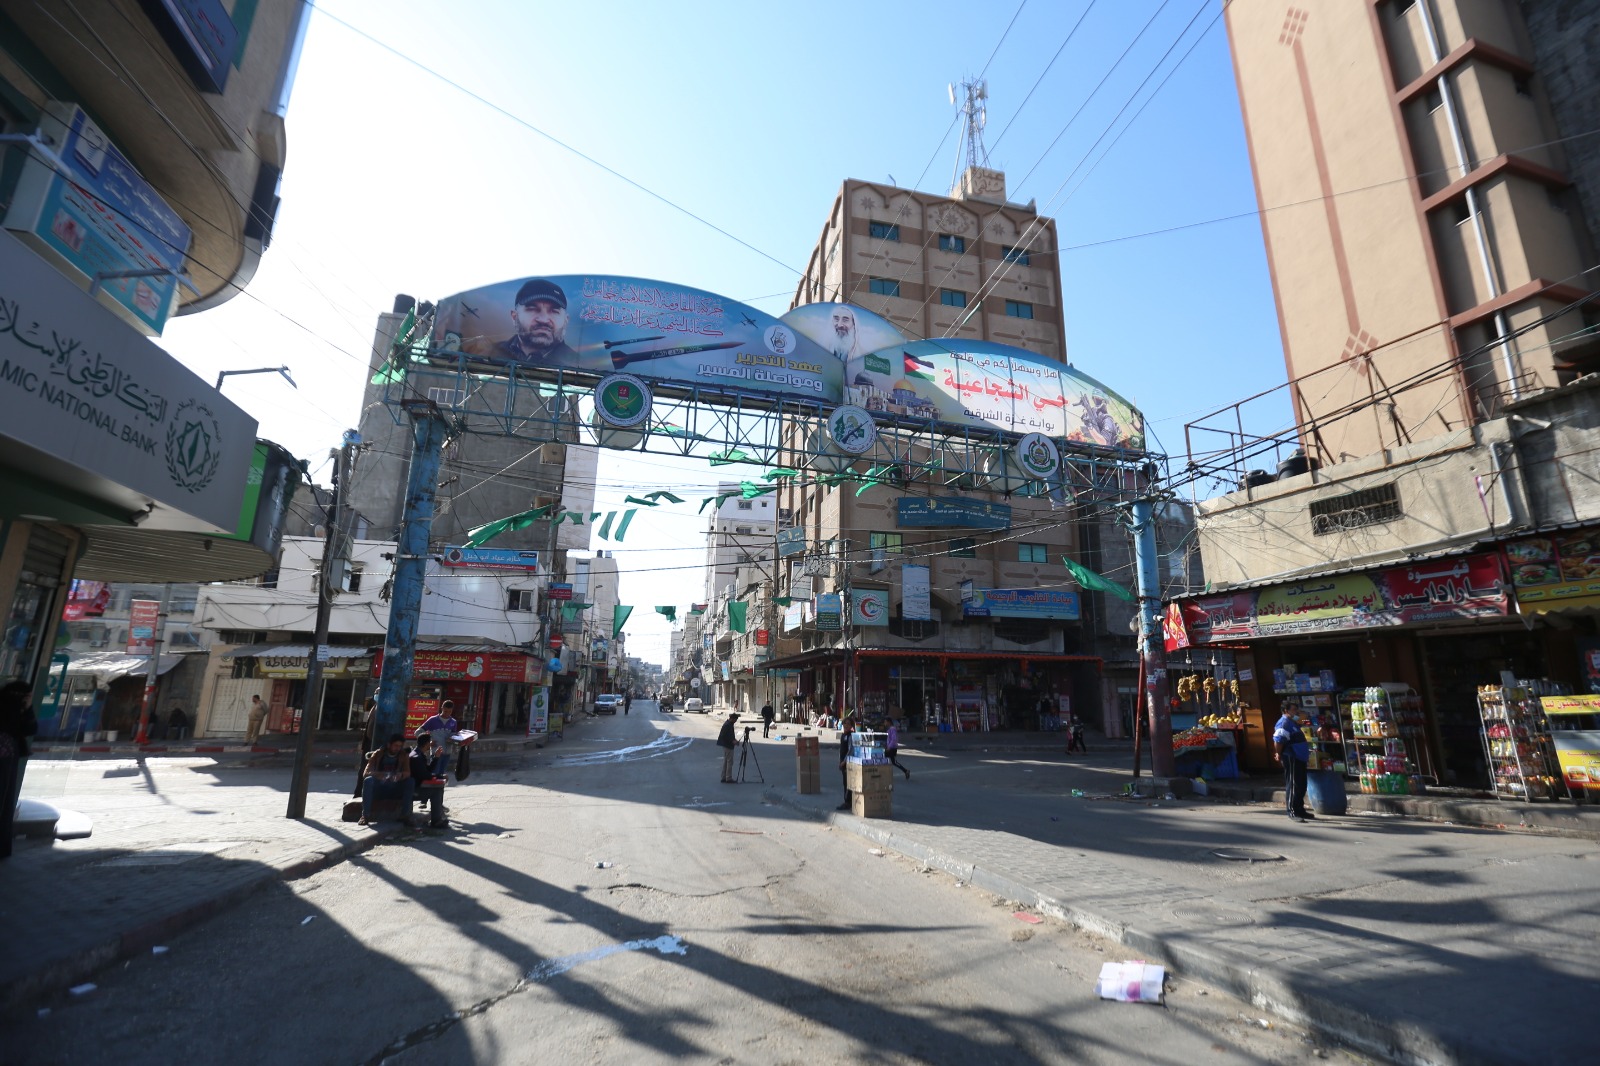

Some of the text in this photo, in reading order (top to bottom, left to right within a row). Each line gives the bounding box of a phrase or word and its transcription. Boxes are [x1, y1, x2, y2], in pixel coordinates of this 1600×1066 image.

[735, 352, 823, 374] عهد التحرير
[949, 351, 974, 363] قلعة
[976, 358, 991, 370] في
[993, 359, 1009, 370] بكم
[698, 363, 824, 392] ومواصلة المسير
[0, 358, 158, 457] MIC NATIONAL BANK
[1033, 394, 1069, 412] حي
[963, 406, 1055, 432] بوابة غزة الشرقية
[1407, 559, 1470, 584] قهوة
[986, 590, 1018, 602] الرحيمة
[1287, 583, 1336, 596] محلات
[1019, 592, 1050, 604] القلوب
